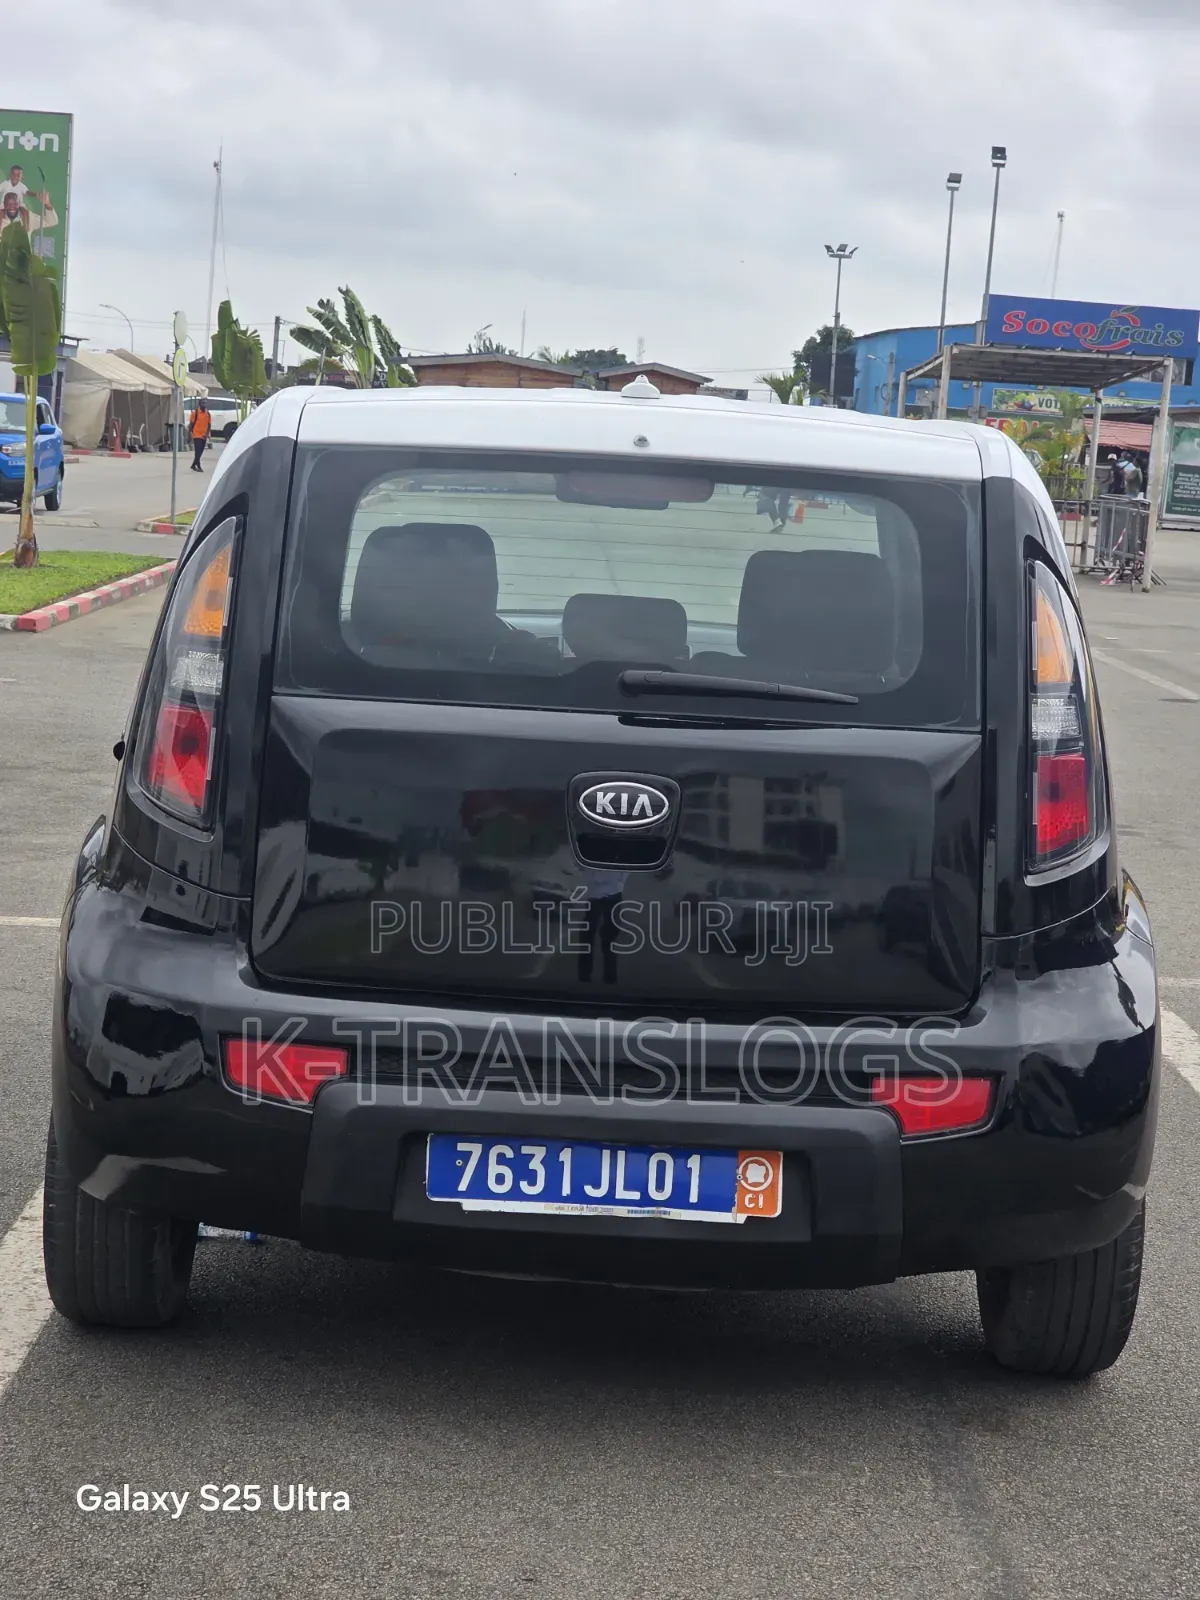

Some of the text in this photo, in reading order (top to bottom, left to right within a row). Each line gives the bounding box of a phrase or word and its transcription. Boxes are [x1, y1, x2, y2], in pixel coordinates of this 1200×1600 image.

[0, 130, 59, 152] TON
[1002, 310, 1185, 346] Socofrais
[1037, 397, 1061, 410] VOT
[595, 790, 655, 817] KIA
[744, 1193, 763, 1209] CI
